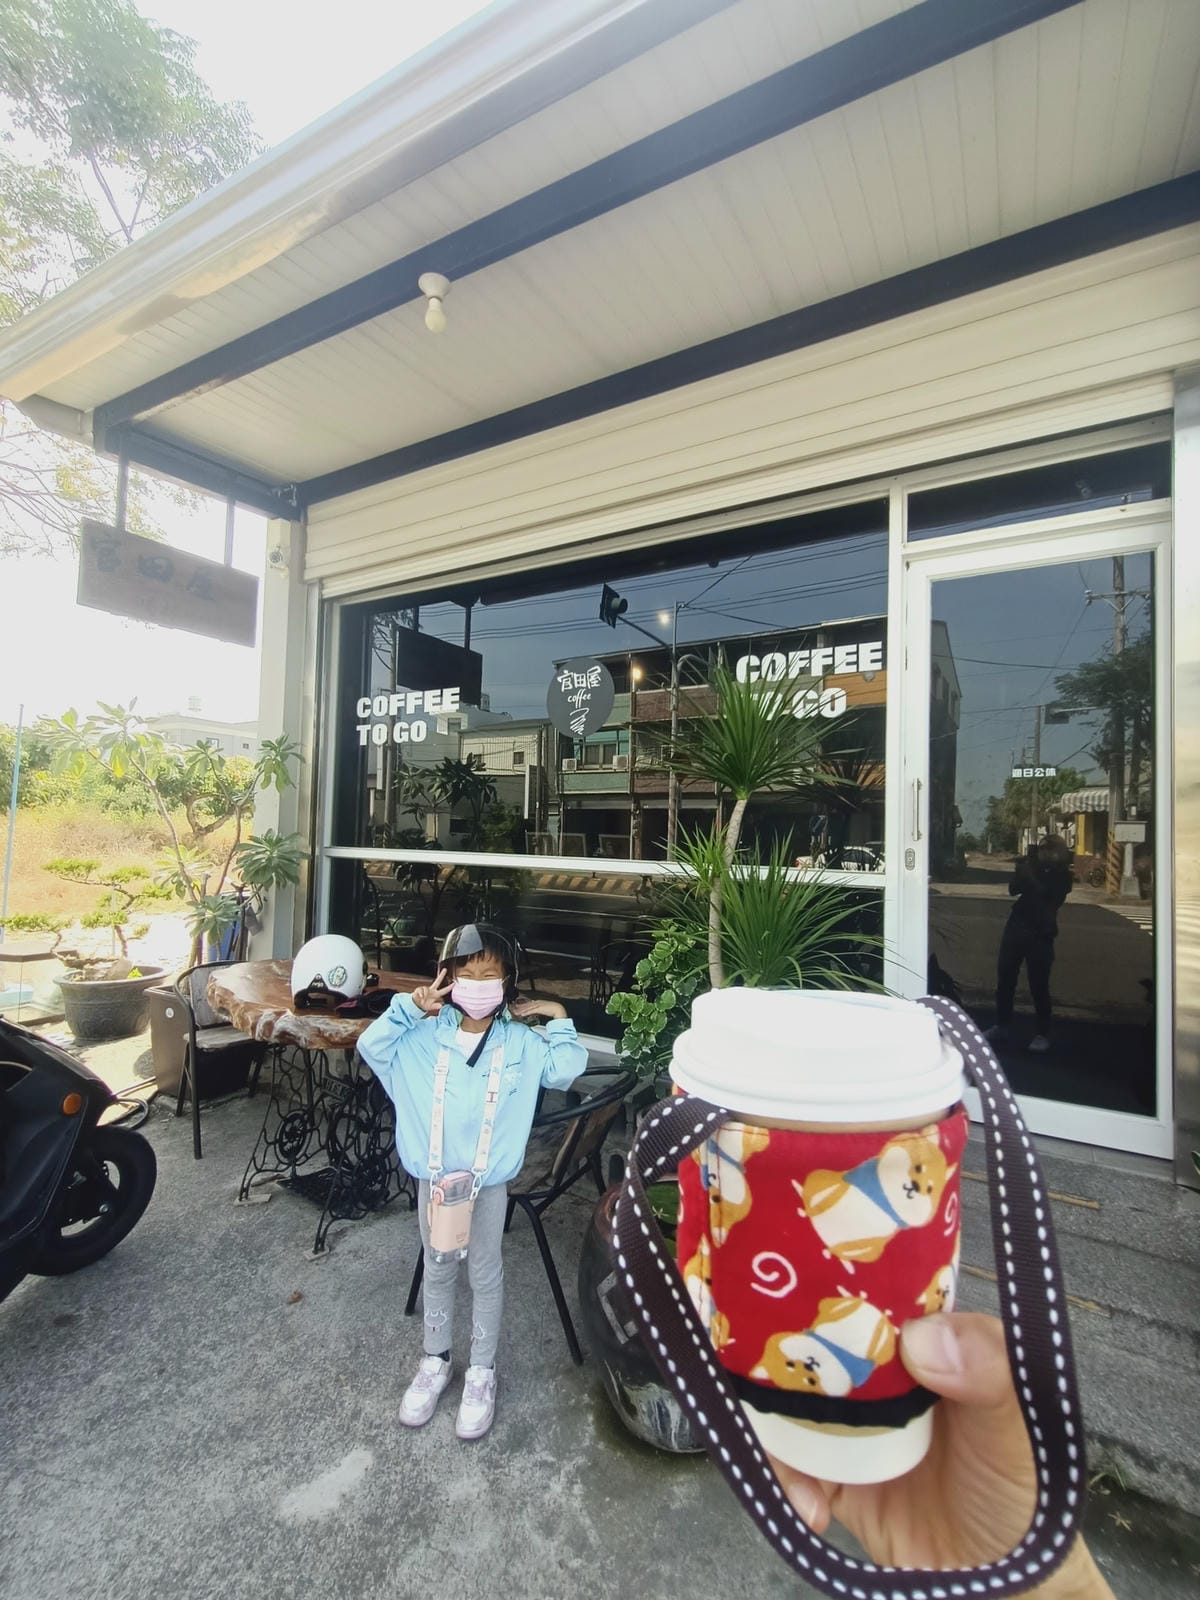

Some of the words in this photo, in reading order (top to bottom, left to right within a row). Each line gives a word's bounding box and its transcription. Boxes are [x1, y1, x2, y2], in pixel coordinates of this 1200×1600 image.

[736, 641, 883, 684] COFFEE
[557, 665, 602, 692] 官田屋
[356, 687, 460, 718] COFFEE
[567, 688, 592, 709] coffee
[792, 687, 847, 720] GO
[356, 725, 388, 746] TO
[393, 721, 427, 742] GO
